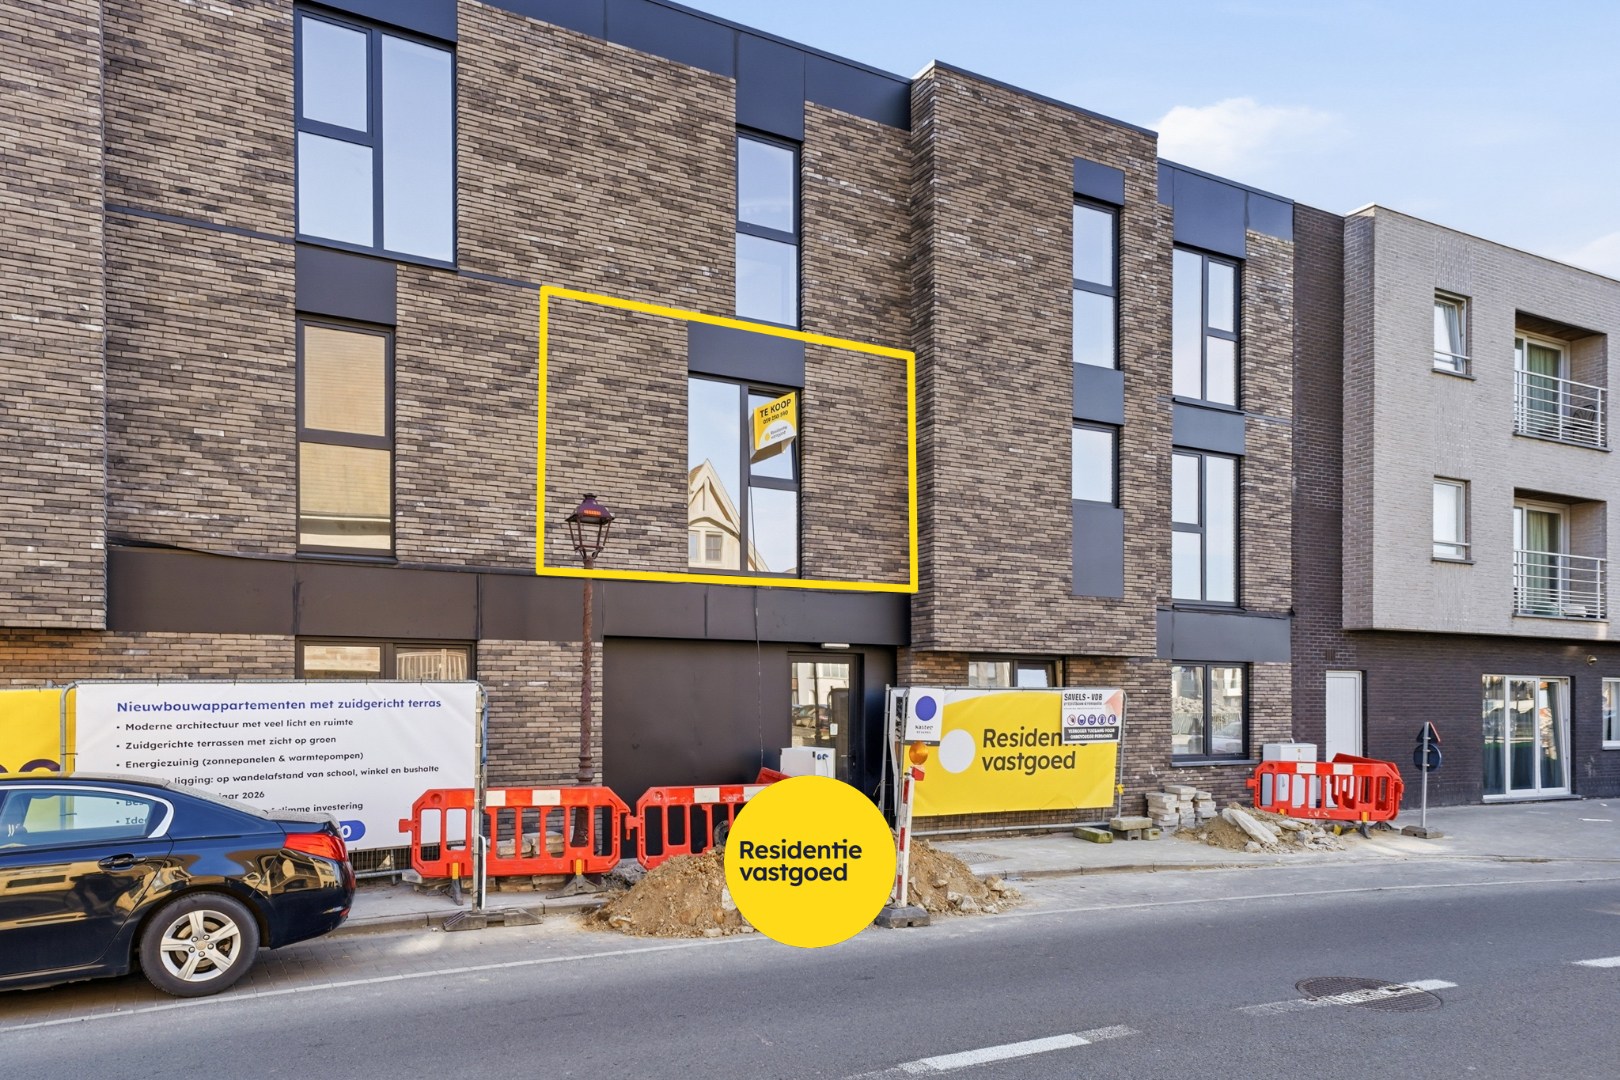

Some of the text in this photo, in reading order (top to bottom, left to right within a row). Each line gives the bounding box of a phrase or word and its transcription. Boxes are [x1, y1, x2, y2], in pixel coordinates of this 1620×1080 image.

[760, 399, 791, 418] TE KOOP
[1064, 693, 1087, 701] SAVELS
[117, 699, 441, 713] Nieuwbouwappartementen met zuidgericht terras
[125, 718, 354, 731] Moderne architectuur met veel licht en ruimte
[125, 736, 337, 751] Zuidgerichte terrassen met zicht op groen
[983, 726, 1088, 748] Residen
[125, 752, 364, 769] Energiezuinig (zonnepanelen & warmtepompen)
[982, 751, 1076, 776] vastgoed
[174, 775, 214, 786] ligging:
[232, 770, 304, 781] wandelafstand
[326, 769, 358, 777] school,
[360, 767, 389, 775] winkel
[403, 765, 439, 773] bushalte
[242, 790, 265, 799] 2026
[313, 802, 364, 813] investering
